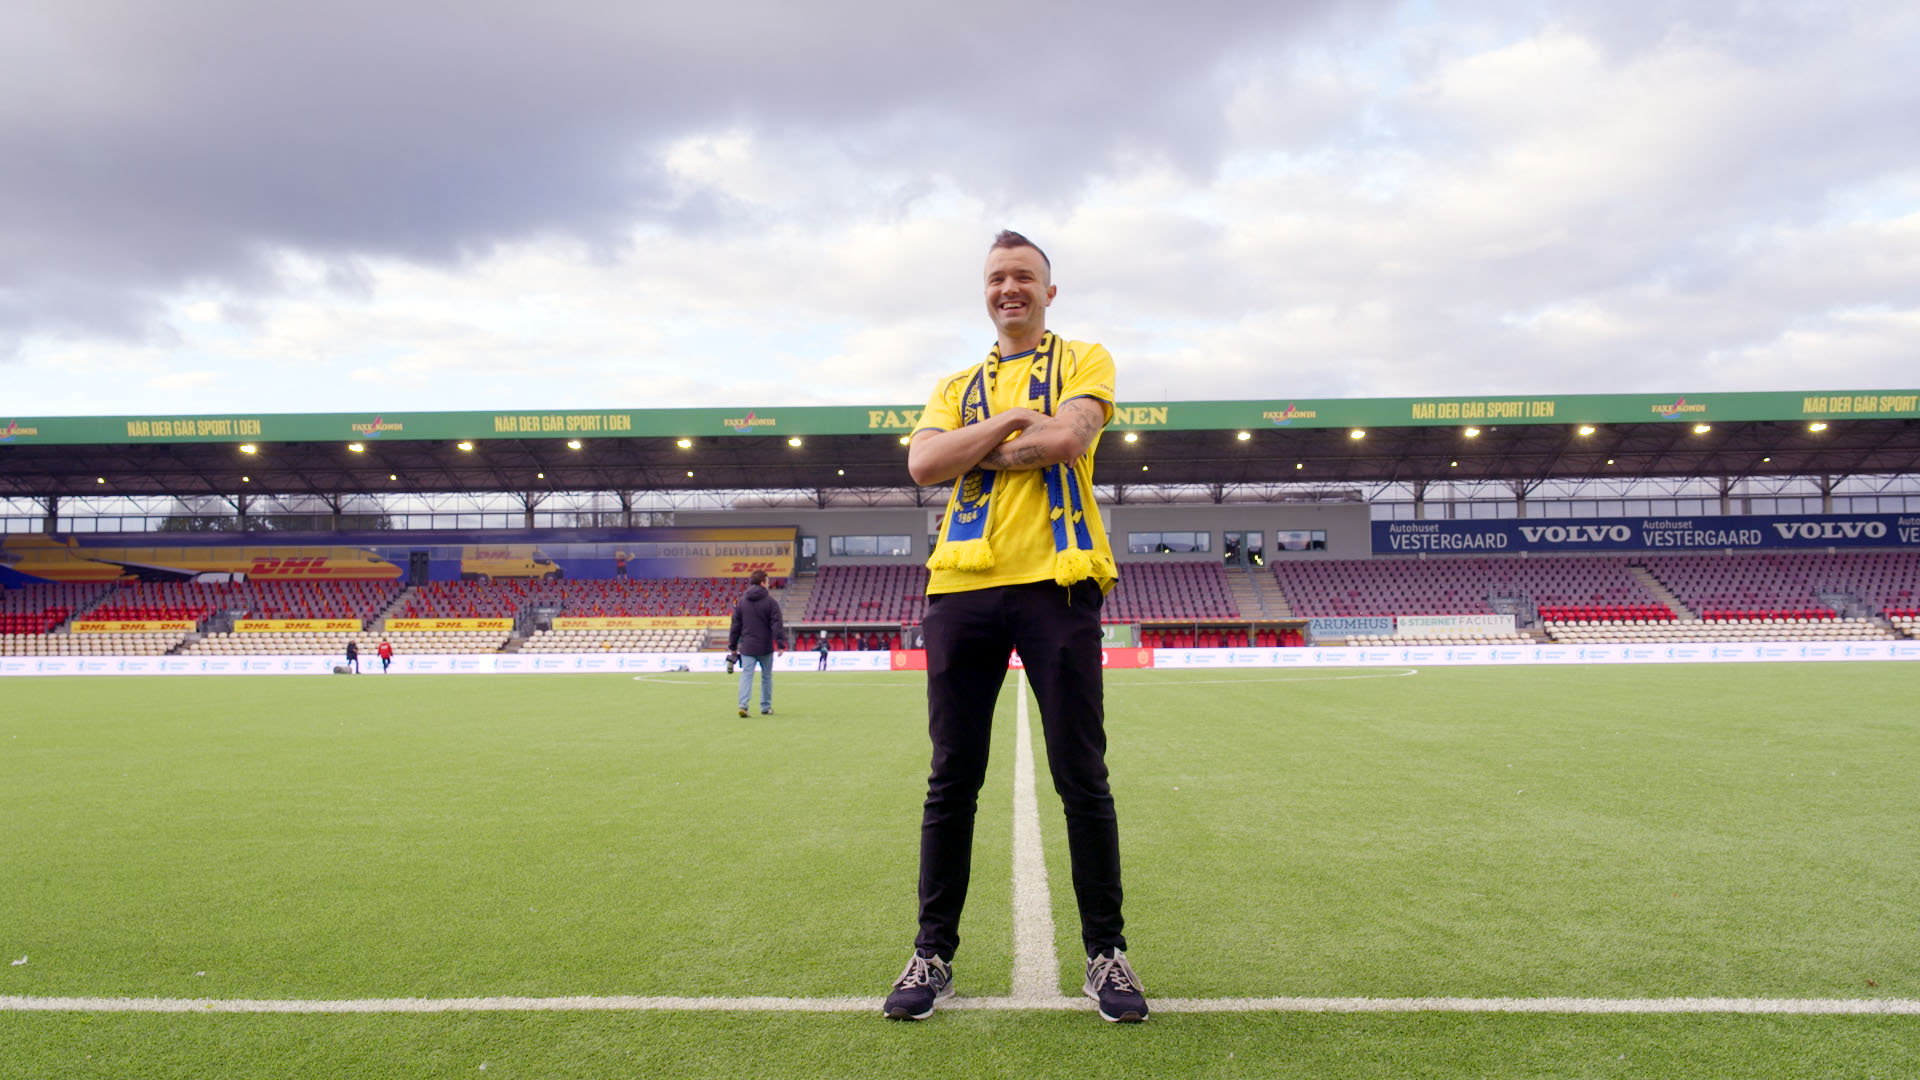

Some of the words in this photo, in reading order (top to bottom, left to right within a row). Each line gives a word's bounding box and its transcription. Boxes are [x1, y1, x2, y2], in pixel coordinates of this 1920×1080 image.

[1438, 403, 1459, 419] DER
[1487, 402, 1524, 418] SPORT
[1533, 401, 1555, 417] DEN
[1829, 397, 1851, 413] DER
[1880, 396, 1916, 411] SPORT
[520, 416, 541, 432] DER
[566, 416, 601, 431] SPORT
[609, 415, 631, 430] DEN
[868, 410, 925, 428] FAX
[1113, 407, 1168, 425] NEN
[151, 421, 173, 436] DER
[197, 420, 232, 436] SPORT
[240, 420, 261, 435] DEN
[1389, 524, 1439, 533] Autohuset
[1643, 520, 1692, 529] Autohuset
[1898, 517, 1920, 526] Auto
[1518, 525, 1631, 543] VOLVO
[1643, 530, 1762, 546] VESTERGAARD
[1772, 521, 1887, 539] VOLVO
[1898, 527, 1920, 543] VE
[1389, 533, 1508, 550] VESTERGAARD
[715, 546, 773, 557] DELIVERED
[775, 546, 791, 556] BY
[250, 557, 332, 574] DHL
[731, 562, 778, 572] DHL
[1310, 618, 1389, 630] ARUMHUS
[1408, 617, 1457, 626] STJERNET
[1459, 616, 1513, 625] FACILITY
